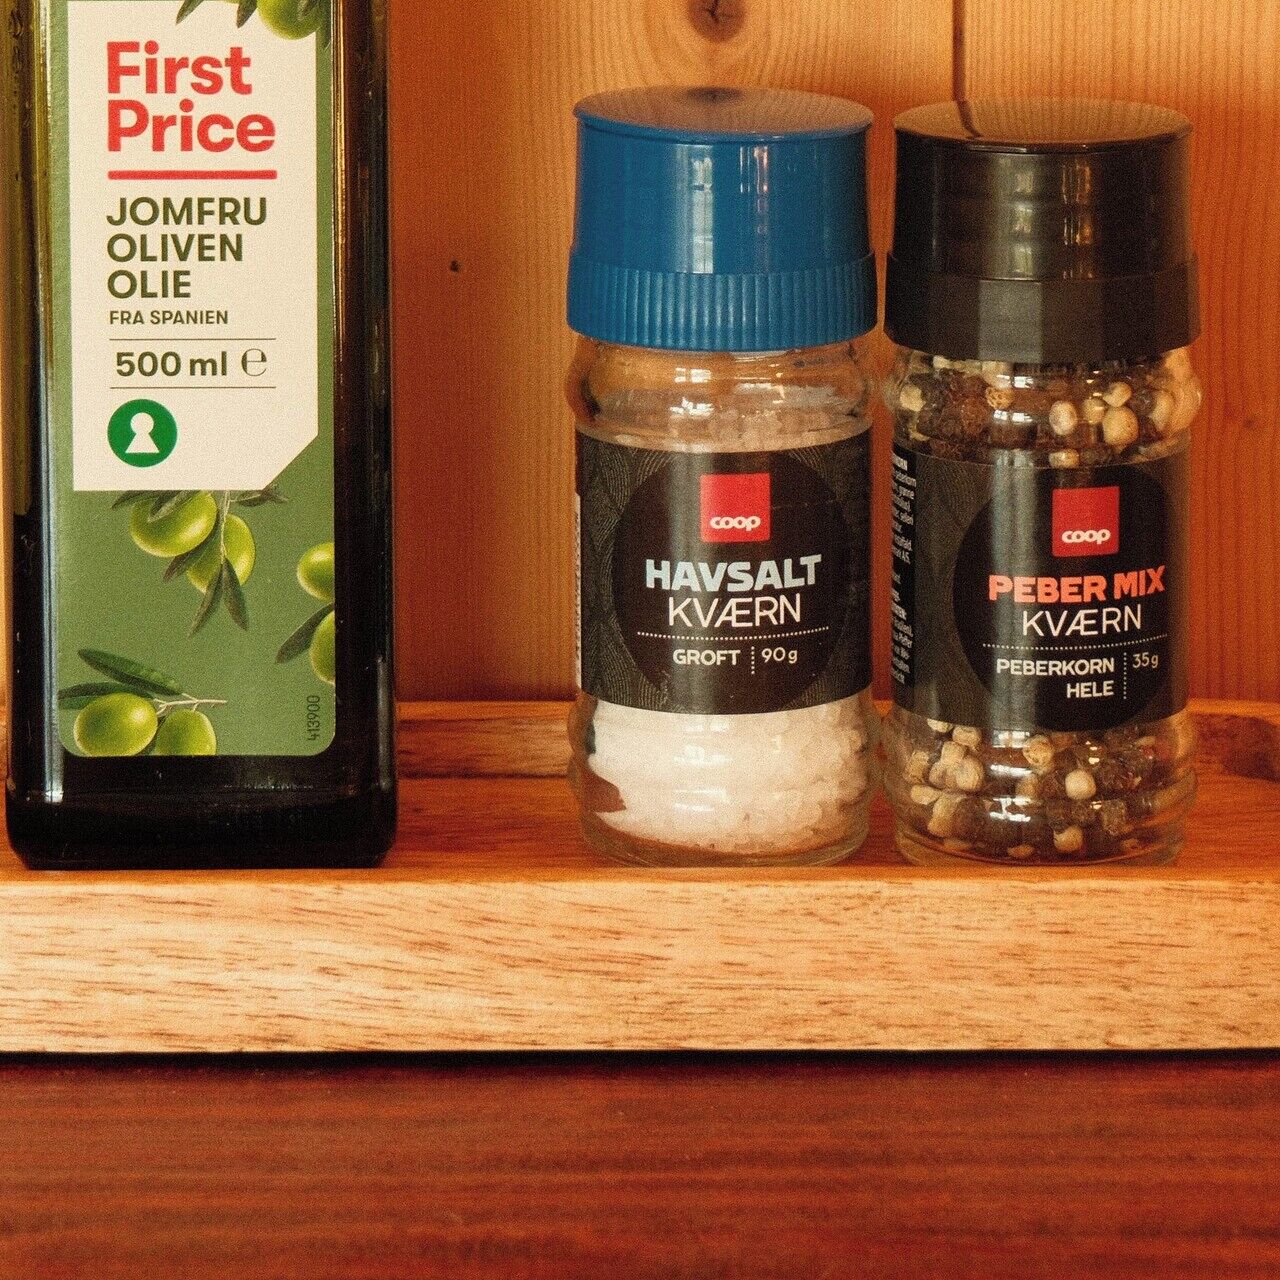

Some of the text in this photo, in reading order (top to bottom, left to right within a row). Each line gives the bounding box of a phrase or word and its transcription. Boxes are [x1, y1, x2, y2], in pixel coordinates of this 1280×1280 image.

[106, 39, 253, 96] First
[106, 98, 277, 154] Price
[106, 196, 267, 227] JOMFRU
[106, 232, 244, 263] OLIVEN
[106, 269, 192, 300] OLIE
[109, 310, 229, 326] FRA SPANIEN
[115, 350, 182, 378] 500
[189, 350, 228, 378] ml
[709, 515, 762, 532] coop
[1061, 528, 1111, 545] coop
[645, 553, 822, 593] HAVSALT
[988, 565, 1166, 604] PEBER MIX
[668, 592, 802, 628] KVÆRN
[1022, 603, 1142, 637] KVÆRN
[672, 646, 799, 666] GROFT 90g
[996, 656, 1115, 676] PEBERKORN
[1132, 651, 1159, 669] 35g
[1066, 680, 1115, 699] HELE
[306, 694, 321, 741] 413900
